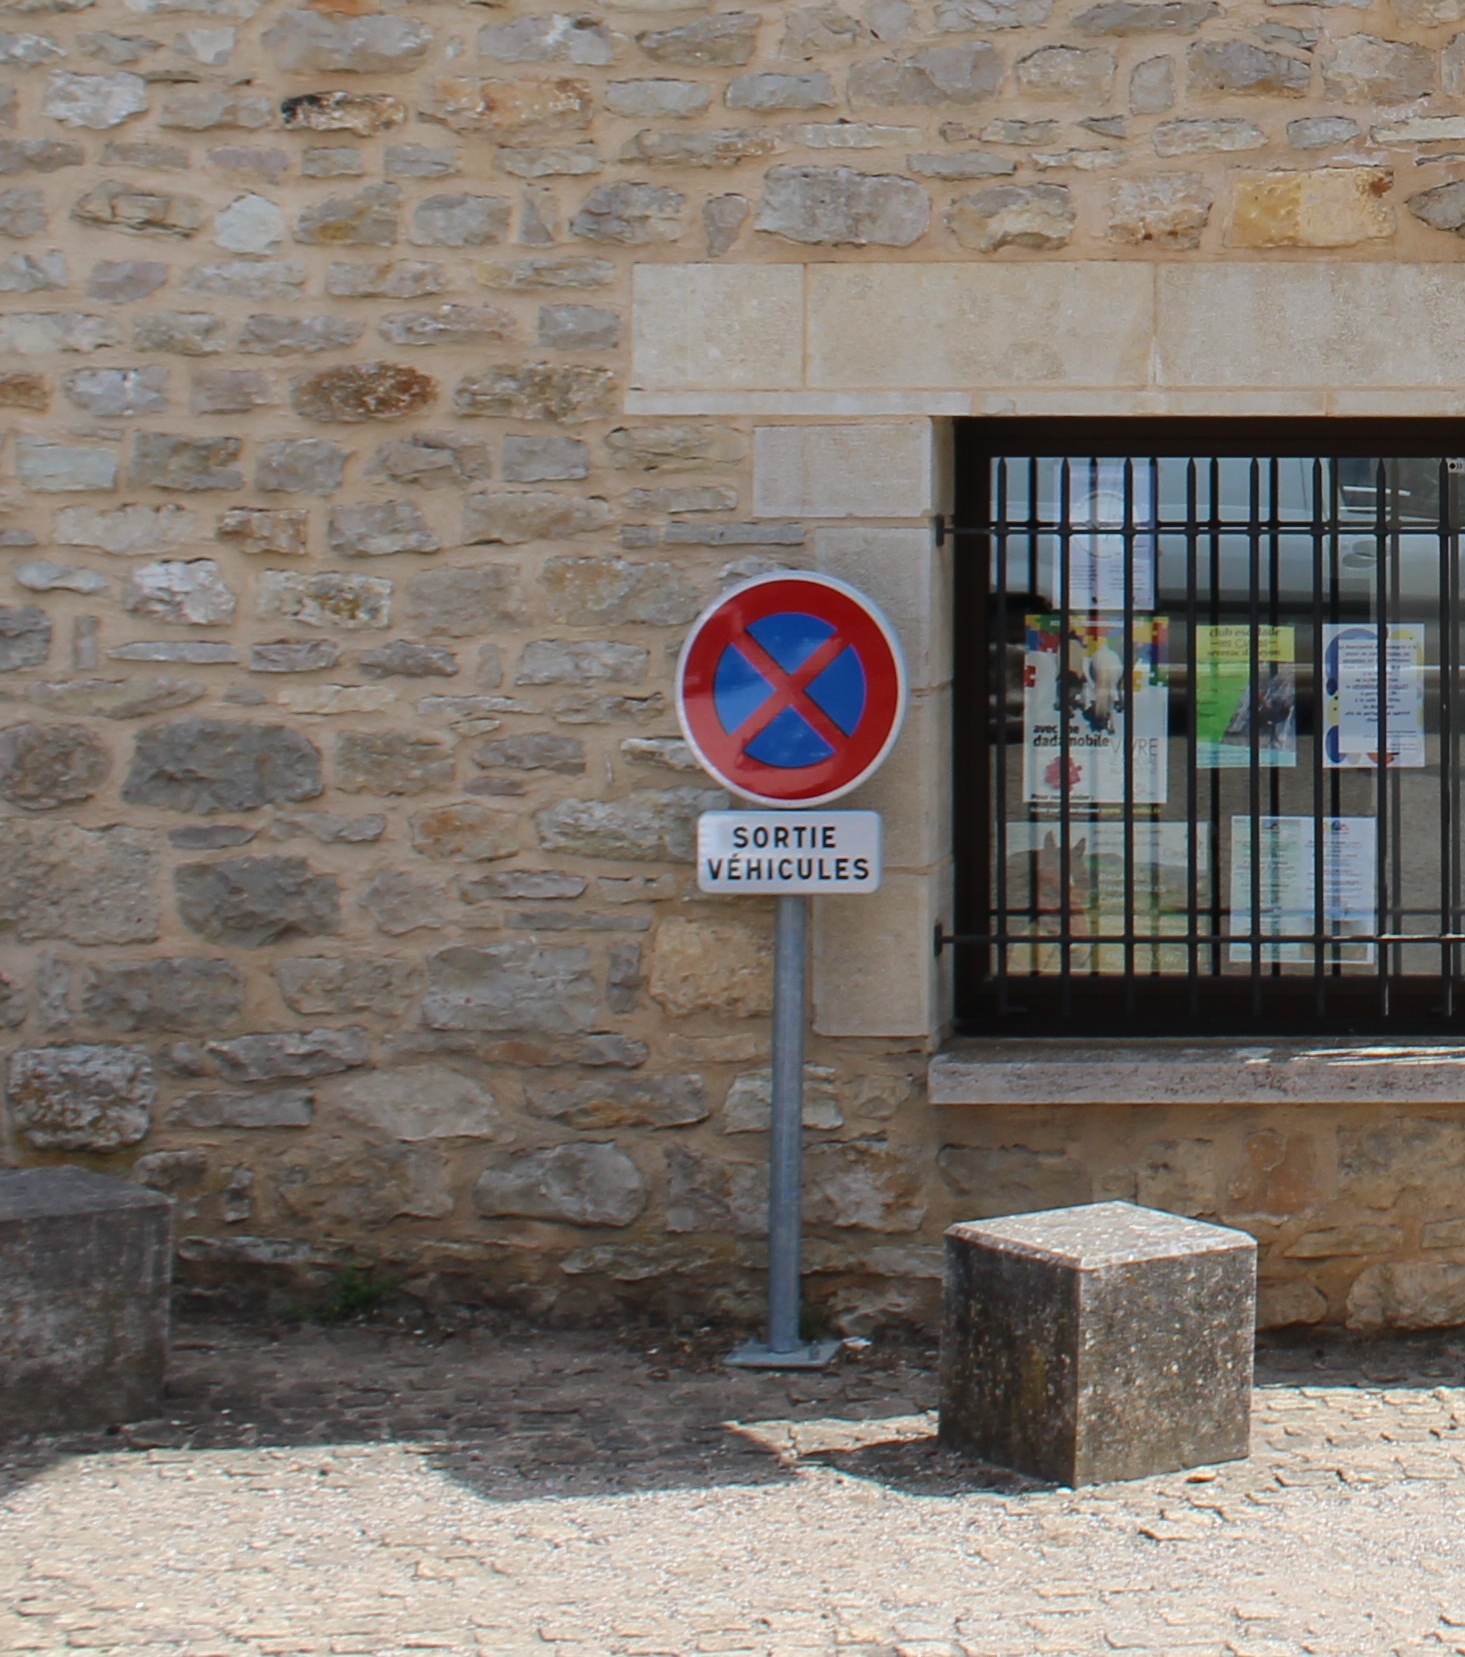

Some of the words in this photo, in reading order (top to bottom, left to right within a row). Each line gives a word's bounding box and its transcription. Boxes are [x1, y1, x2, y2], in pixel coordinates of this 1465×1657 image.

[1033, 725, 1058, 734] avec
[1033, 734, 1110, 747] dadmobile
[732, 825, 837, 849] SORTIE
[706, 852, 870, 881] VÉHICULES
